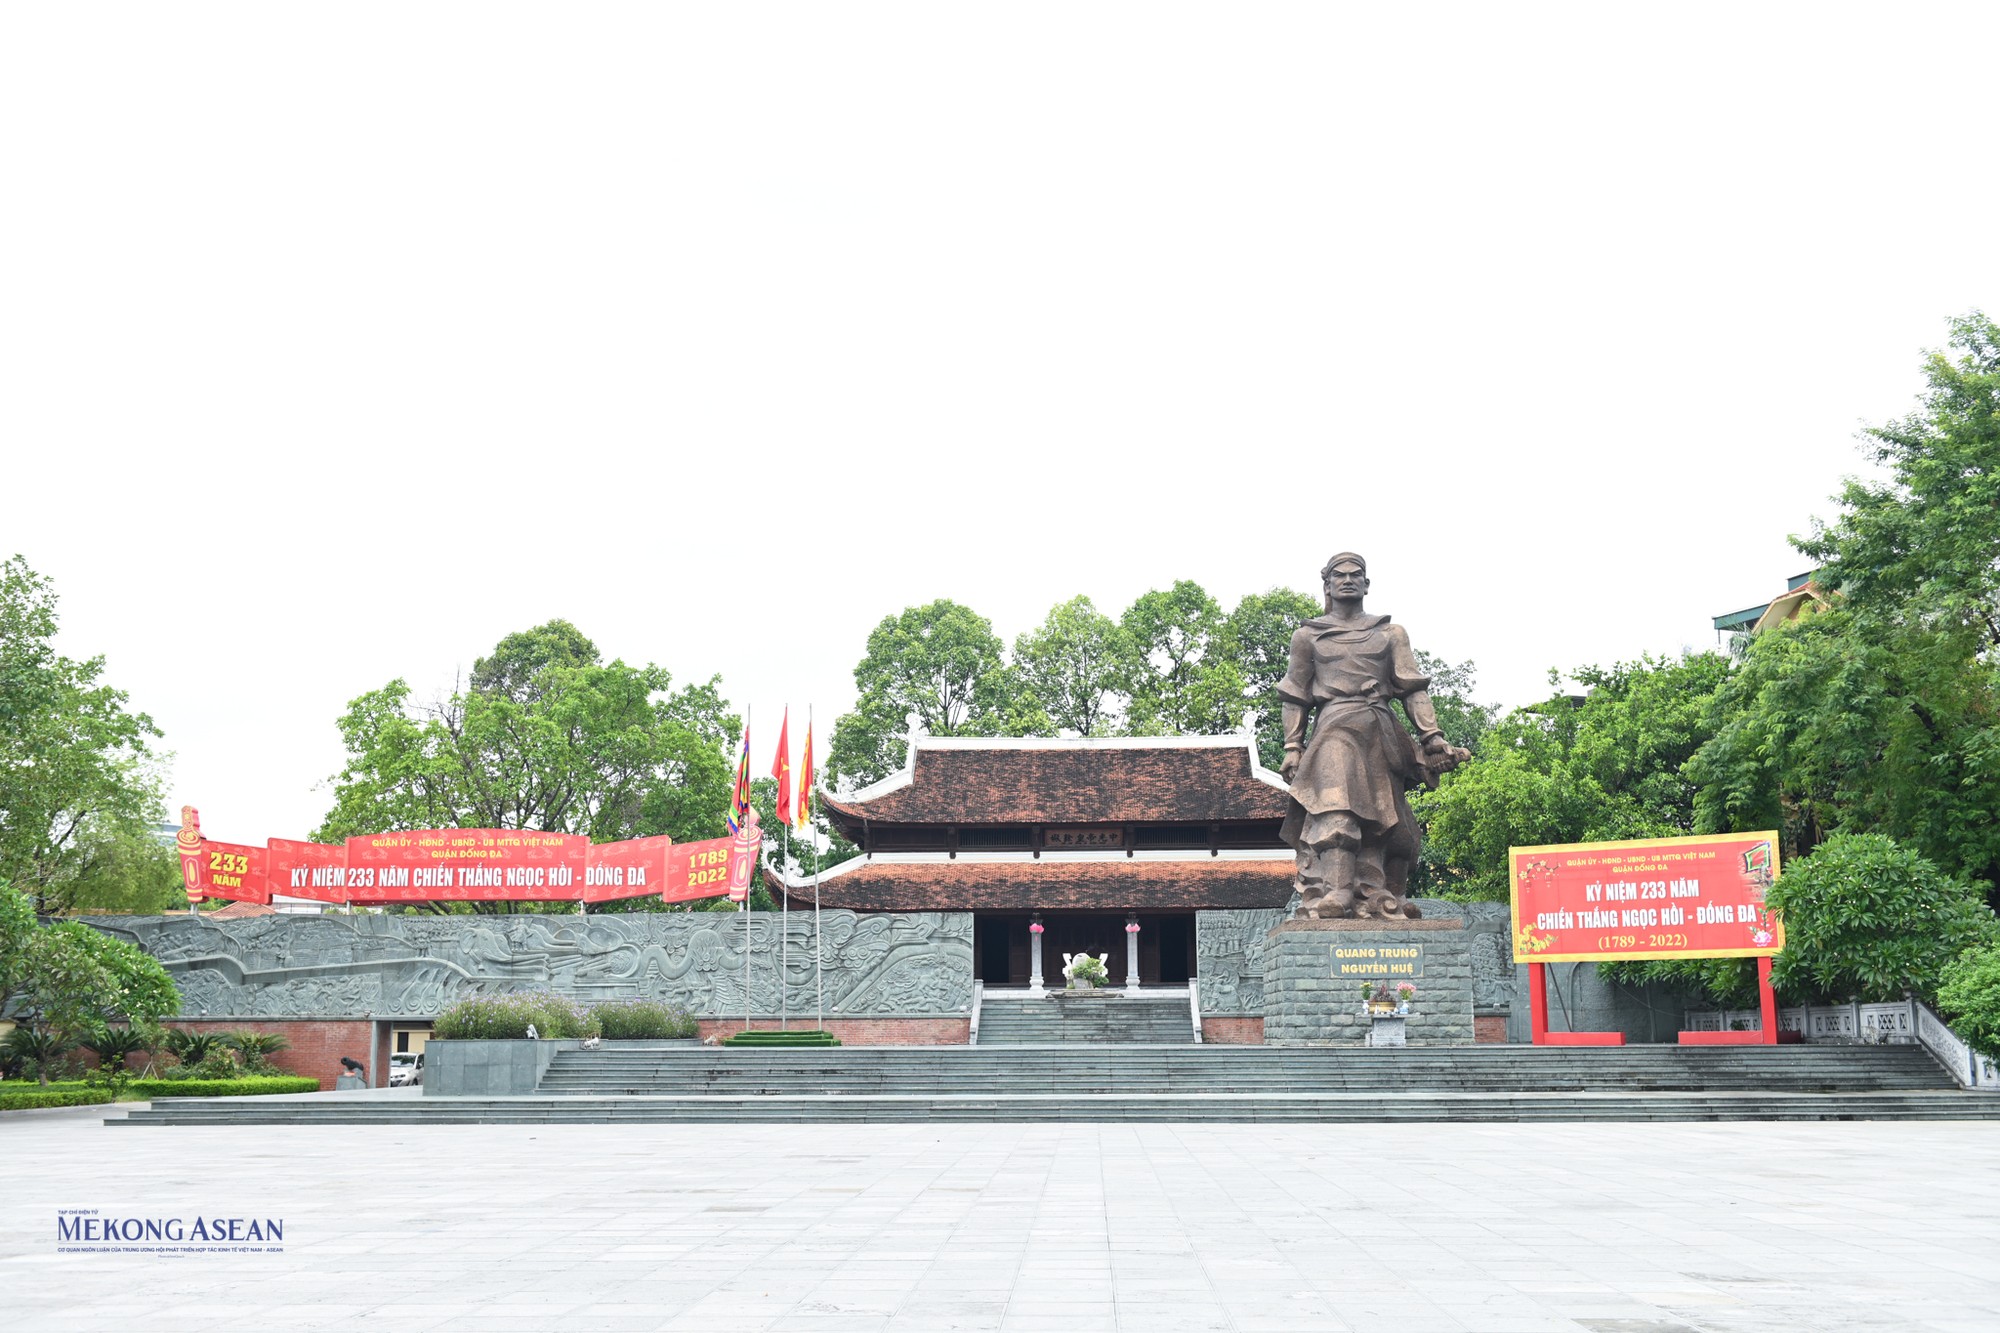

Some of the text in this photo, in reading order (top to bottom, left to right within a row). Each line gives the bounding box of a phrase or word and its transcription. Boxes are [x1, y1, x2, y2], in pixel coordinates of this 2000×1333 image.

[372, 837, 398, 848] QUẬN
[400, 837, 412, 847] ỦY
[419, 839, 444, 847] HĐND
[452, 839, 475, 847] UBND
[523, 837, 540, 848] VIỆT
[432, 848, 502, 859] QUẬN ĐỐNG ĐA
[689, 849, 728, 870] 1789
[1567, 858, 1586, 867] QUẬN
[1602, 857, 1622, 865] HĐND
[1683, 852, 1697, 861] VIỆT
[1699, 851, 1716, 859] NAM
[209, 851, 248, 875] 233
[1612, 865, 1633, 874] QUẬN
[1634, 863, 1656, 872] ĐỐNG
[212, 872, 242, 888] NĂM
[291, 864, 309, 887] KỶ
[312, 865, 345, 890] NIỆM
[348, 867, 375, 887] 233
[379, 865, 409, 887] NĂM
[413, 862, 453, 887] CHIẾN
[457, 863, 502, 887] THẮNG
[507, 867, 545, 890] NGỌC
[549, 861, 573, 887] HỒI
[585, 861, 623, 886] ĐỐNG
[627, 867, 646, 886] ĐA
[688, 866, 727, 887] 2022
[1586, 877, 1699, 903] KỶ NIỆM 233 NĂM
[1537, 906, 1574, 930] CHIẾN
[1577, 903, 1618, 929] THẮNG
[1621, 908, 1658, 931] NGỌC
[1661, 902, 1685, 926] HỒI
[1696, 900, 1734, 925] ĐỐNG
[1737, 904, 1757, 922] ĐA
[1598, 934, 1636, 950] (1789
[1649, 933, 1688, 948] 2022)
[1335, 948, 1418, 958] QUANG TRUNG
[1391, 962, 1413, 975] HUỆ
